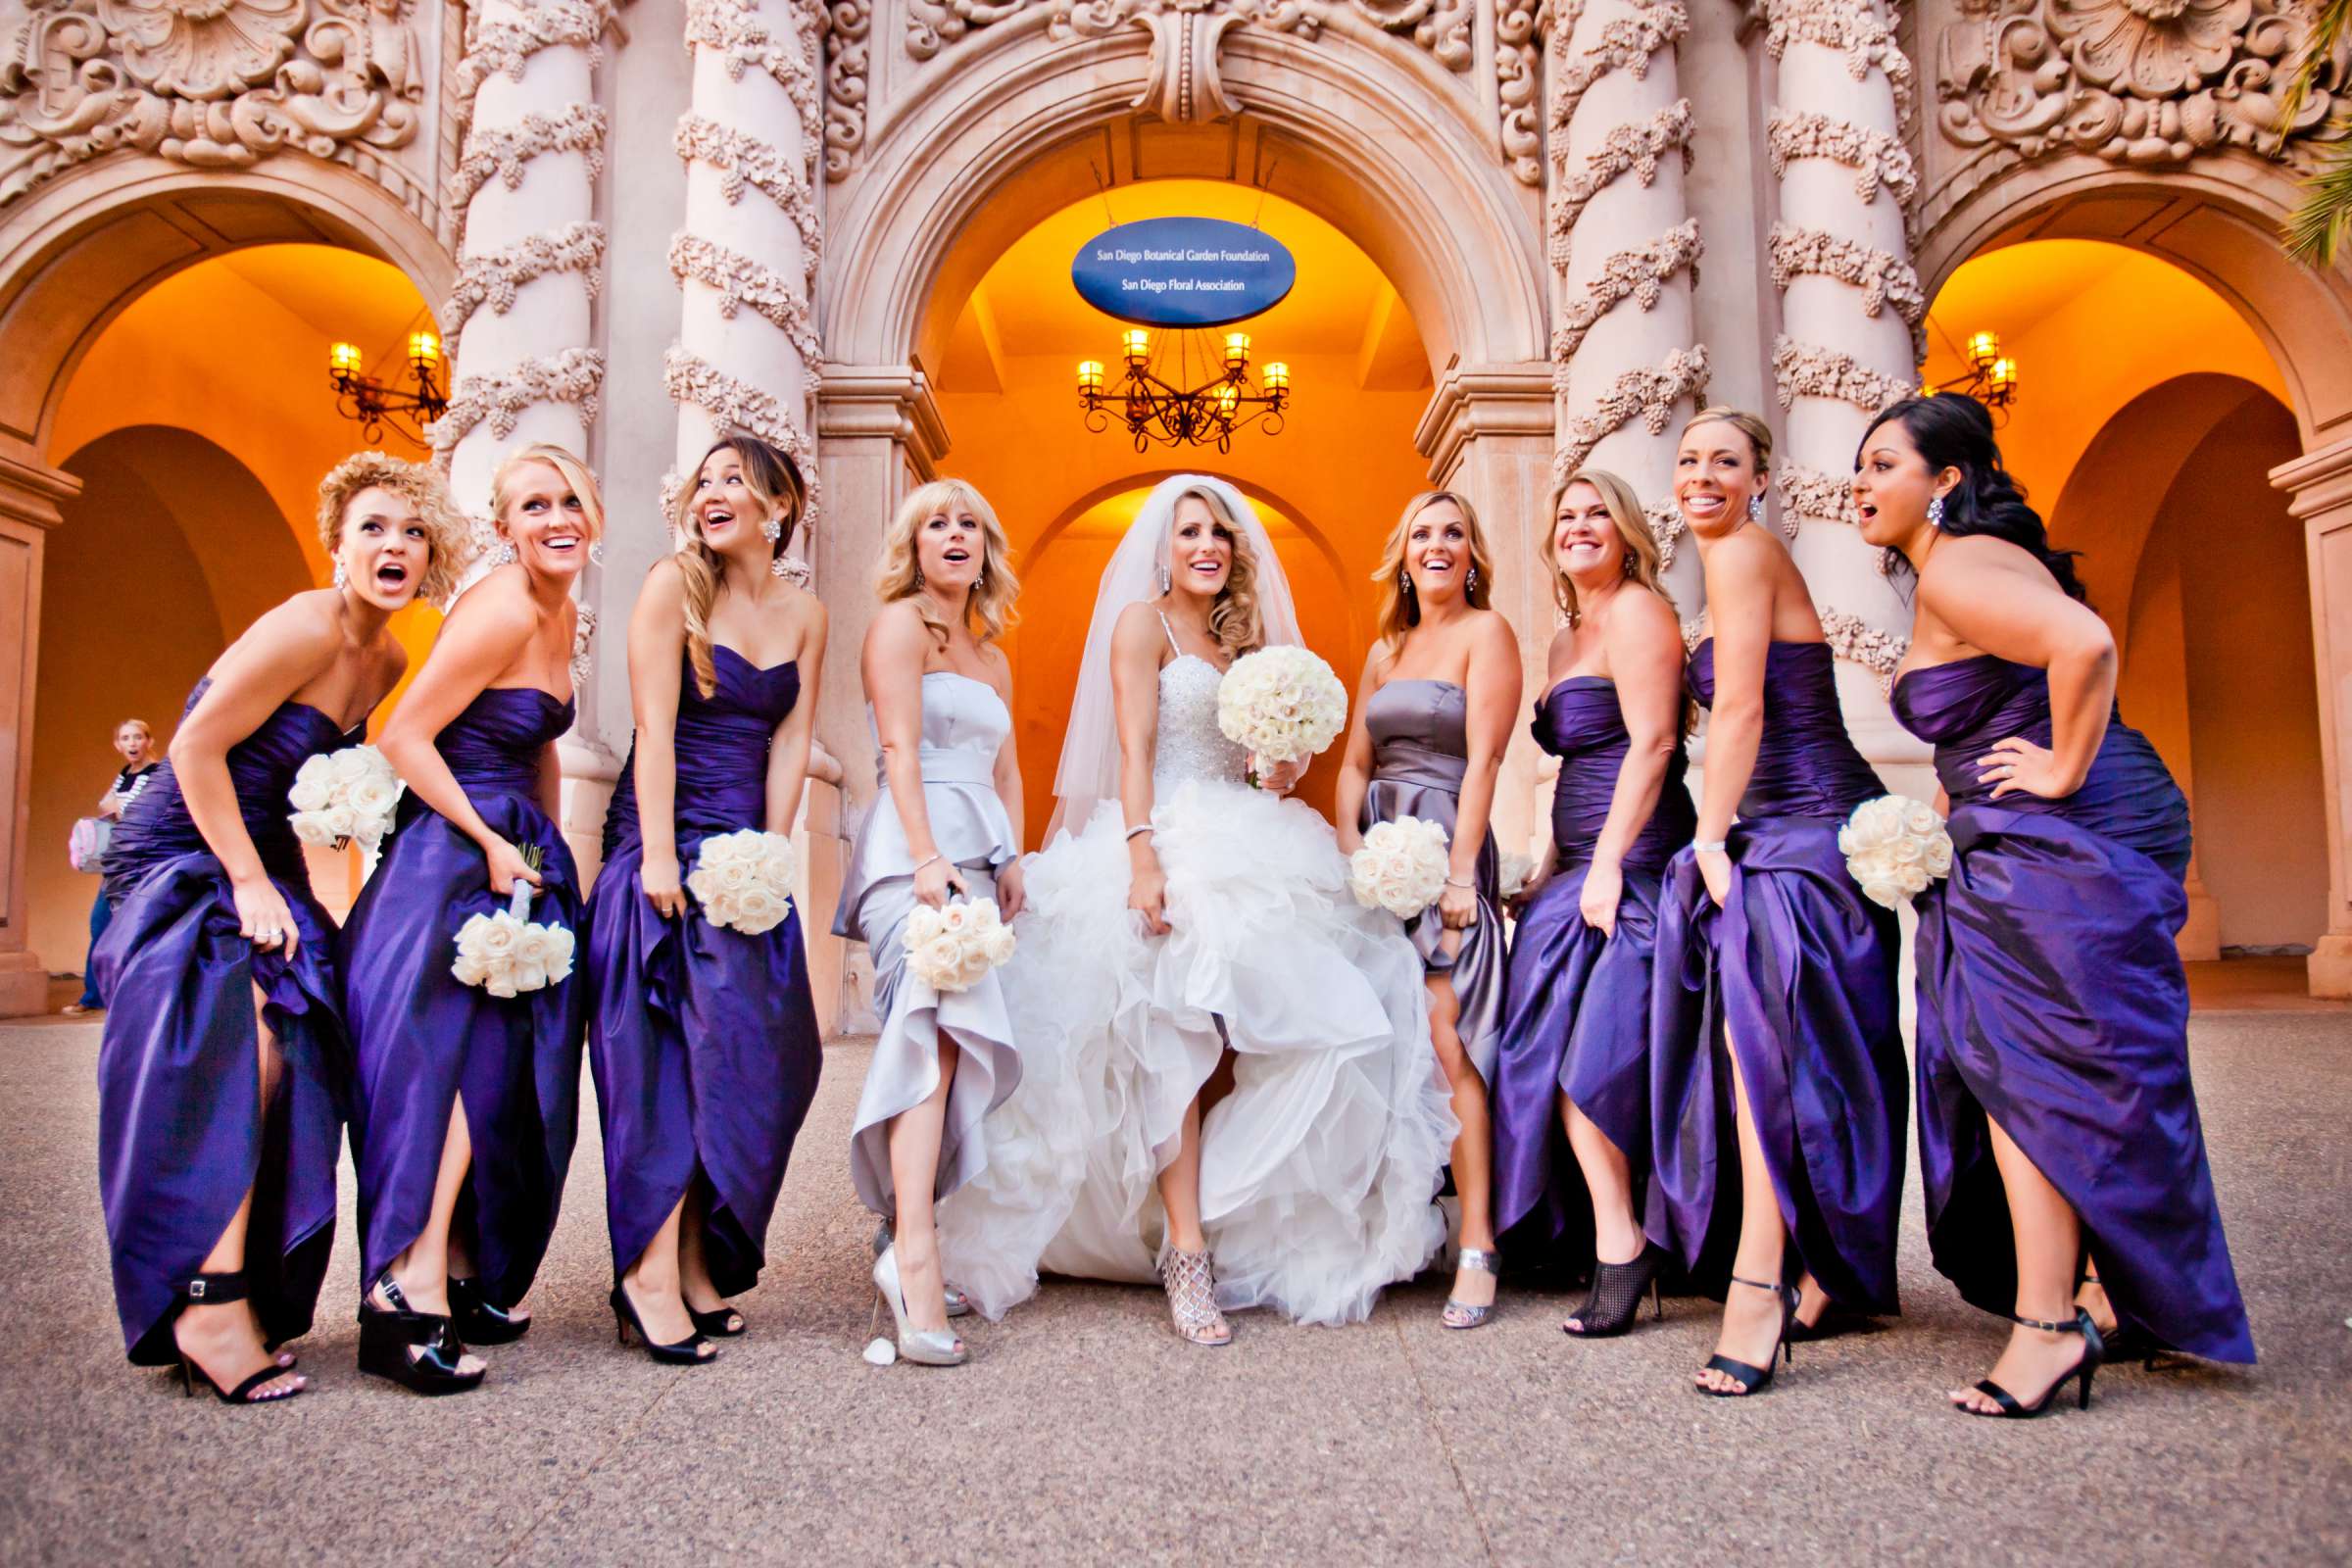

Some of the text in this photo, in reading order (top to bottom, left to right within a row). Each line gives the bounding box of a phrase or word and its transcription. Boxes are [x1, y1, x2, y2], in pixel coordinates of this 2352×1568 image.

[1097, 249, 1270, 264] San Diego Botanical Garden Foundation
[1122, 278, 1245, 294] San Diego Floral Association
